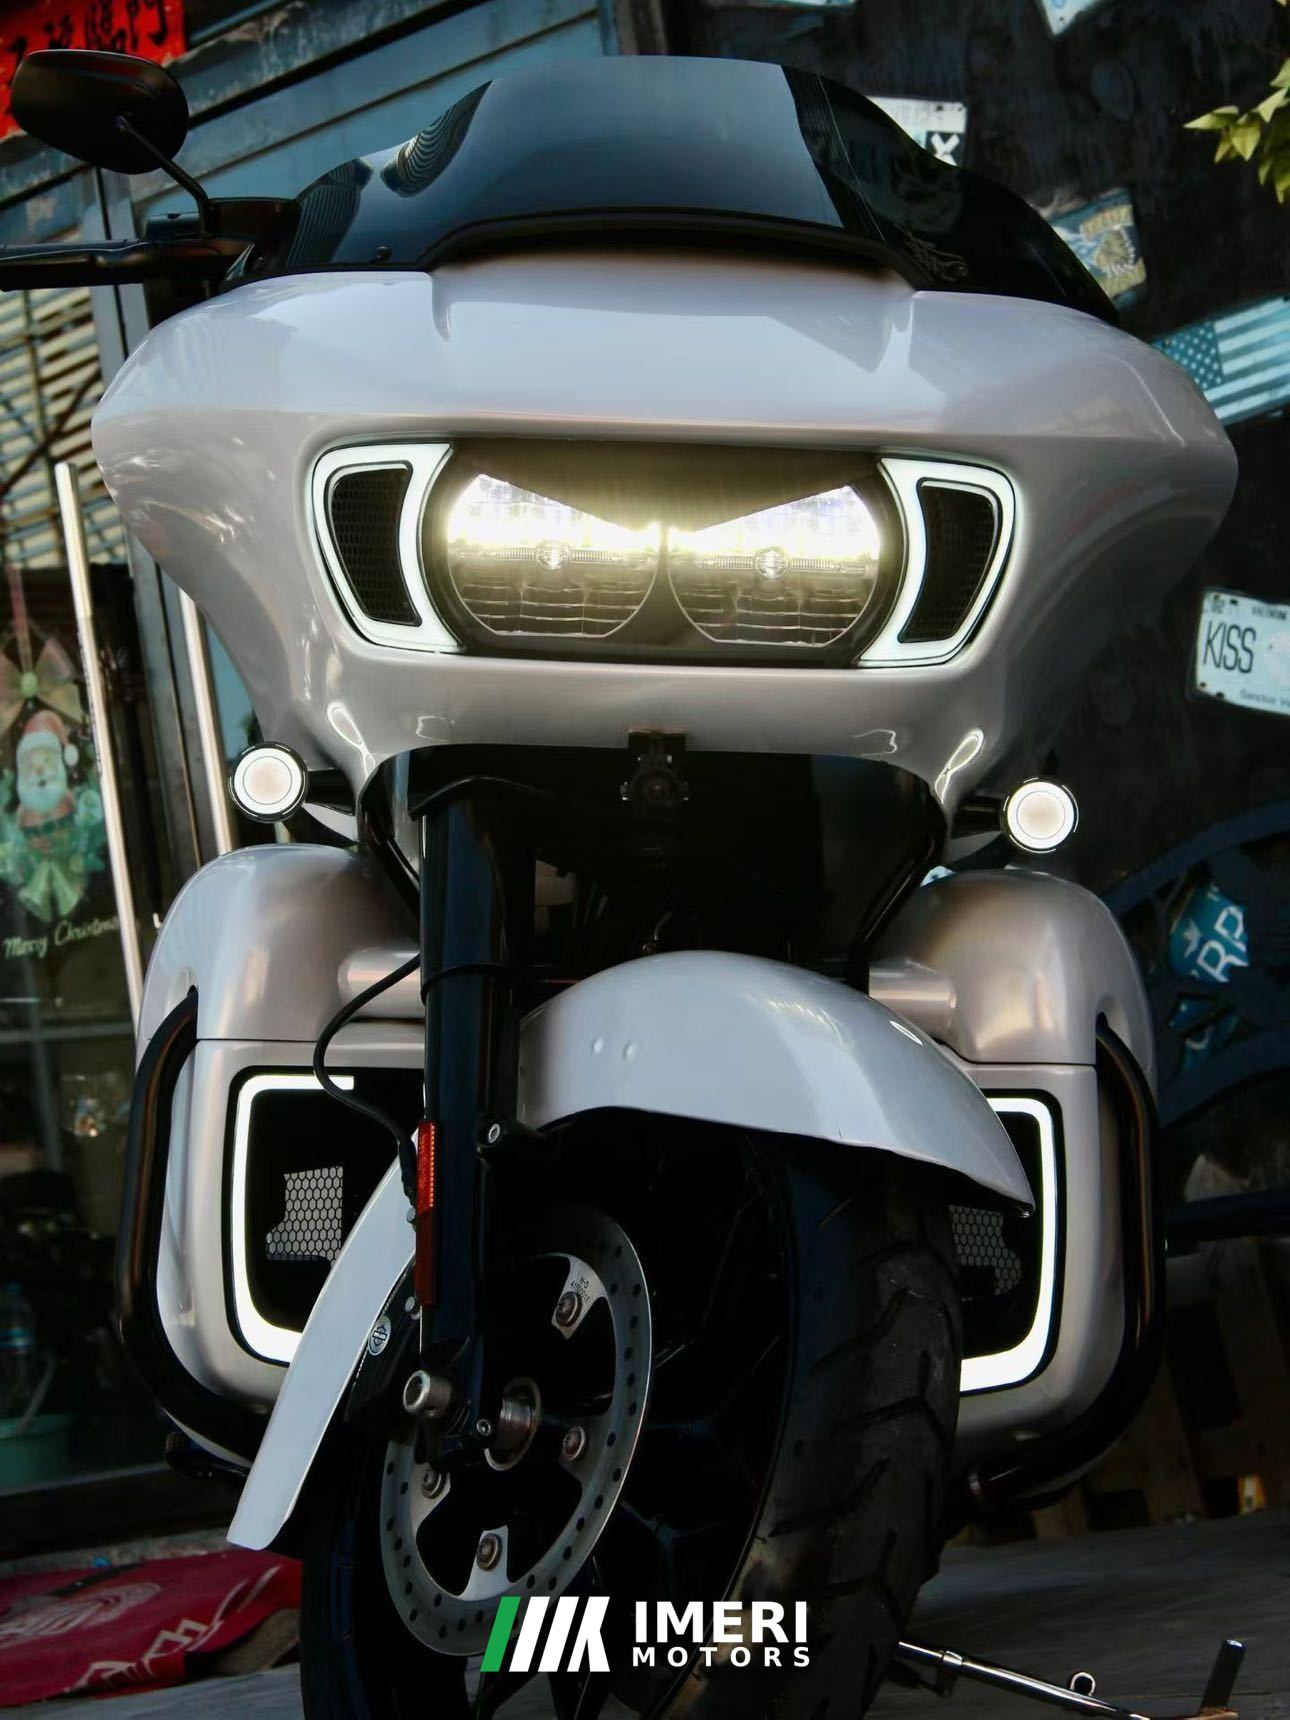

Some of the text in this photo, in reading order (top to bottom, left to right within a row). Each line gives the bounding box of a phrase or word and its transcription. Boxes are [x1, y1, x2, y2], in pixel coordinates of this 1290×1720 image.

[1203, 620, 1257, 674] KISS
[3, 916, 119, 959] Merry Christma
